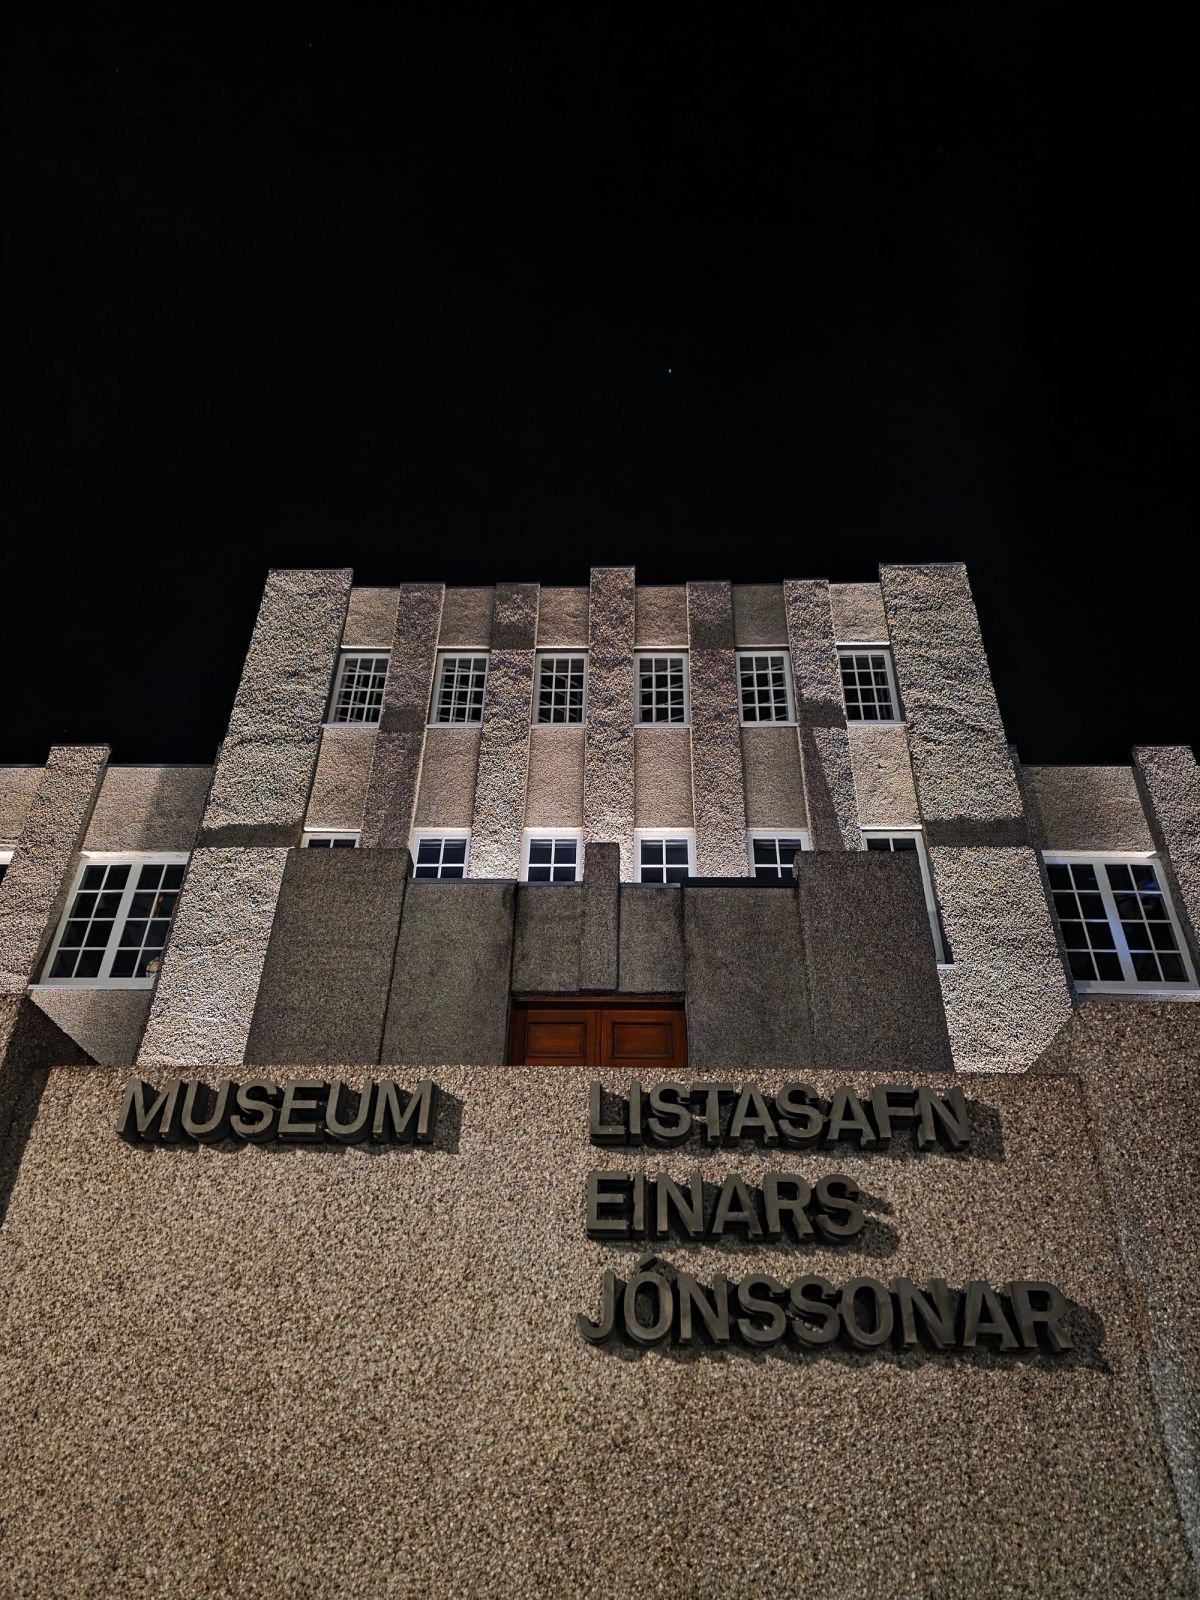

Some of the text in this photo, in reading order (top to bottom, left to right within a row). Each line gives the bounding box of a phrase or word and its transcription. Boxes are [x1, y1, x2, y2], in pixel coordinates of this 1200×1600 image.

[117, 1078, 437, 1142] MUSEUM
[589, 1081, 971, 1149] LISTASAFN
[586, 1171, 866, 1242] EINARS
[576, 1255, 1074, 1352] JÓNSSONAR
